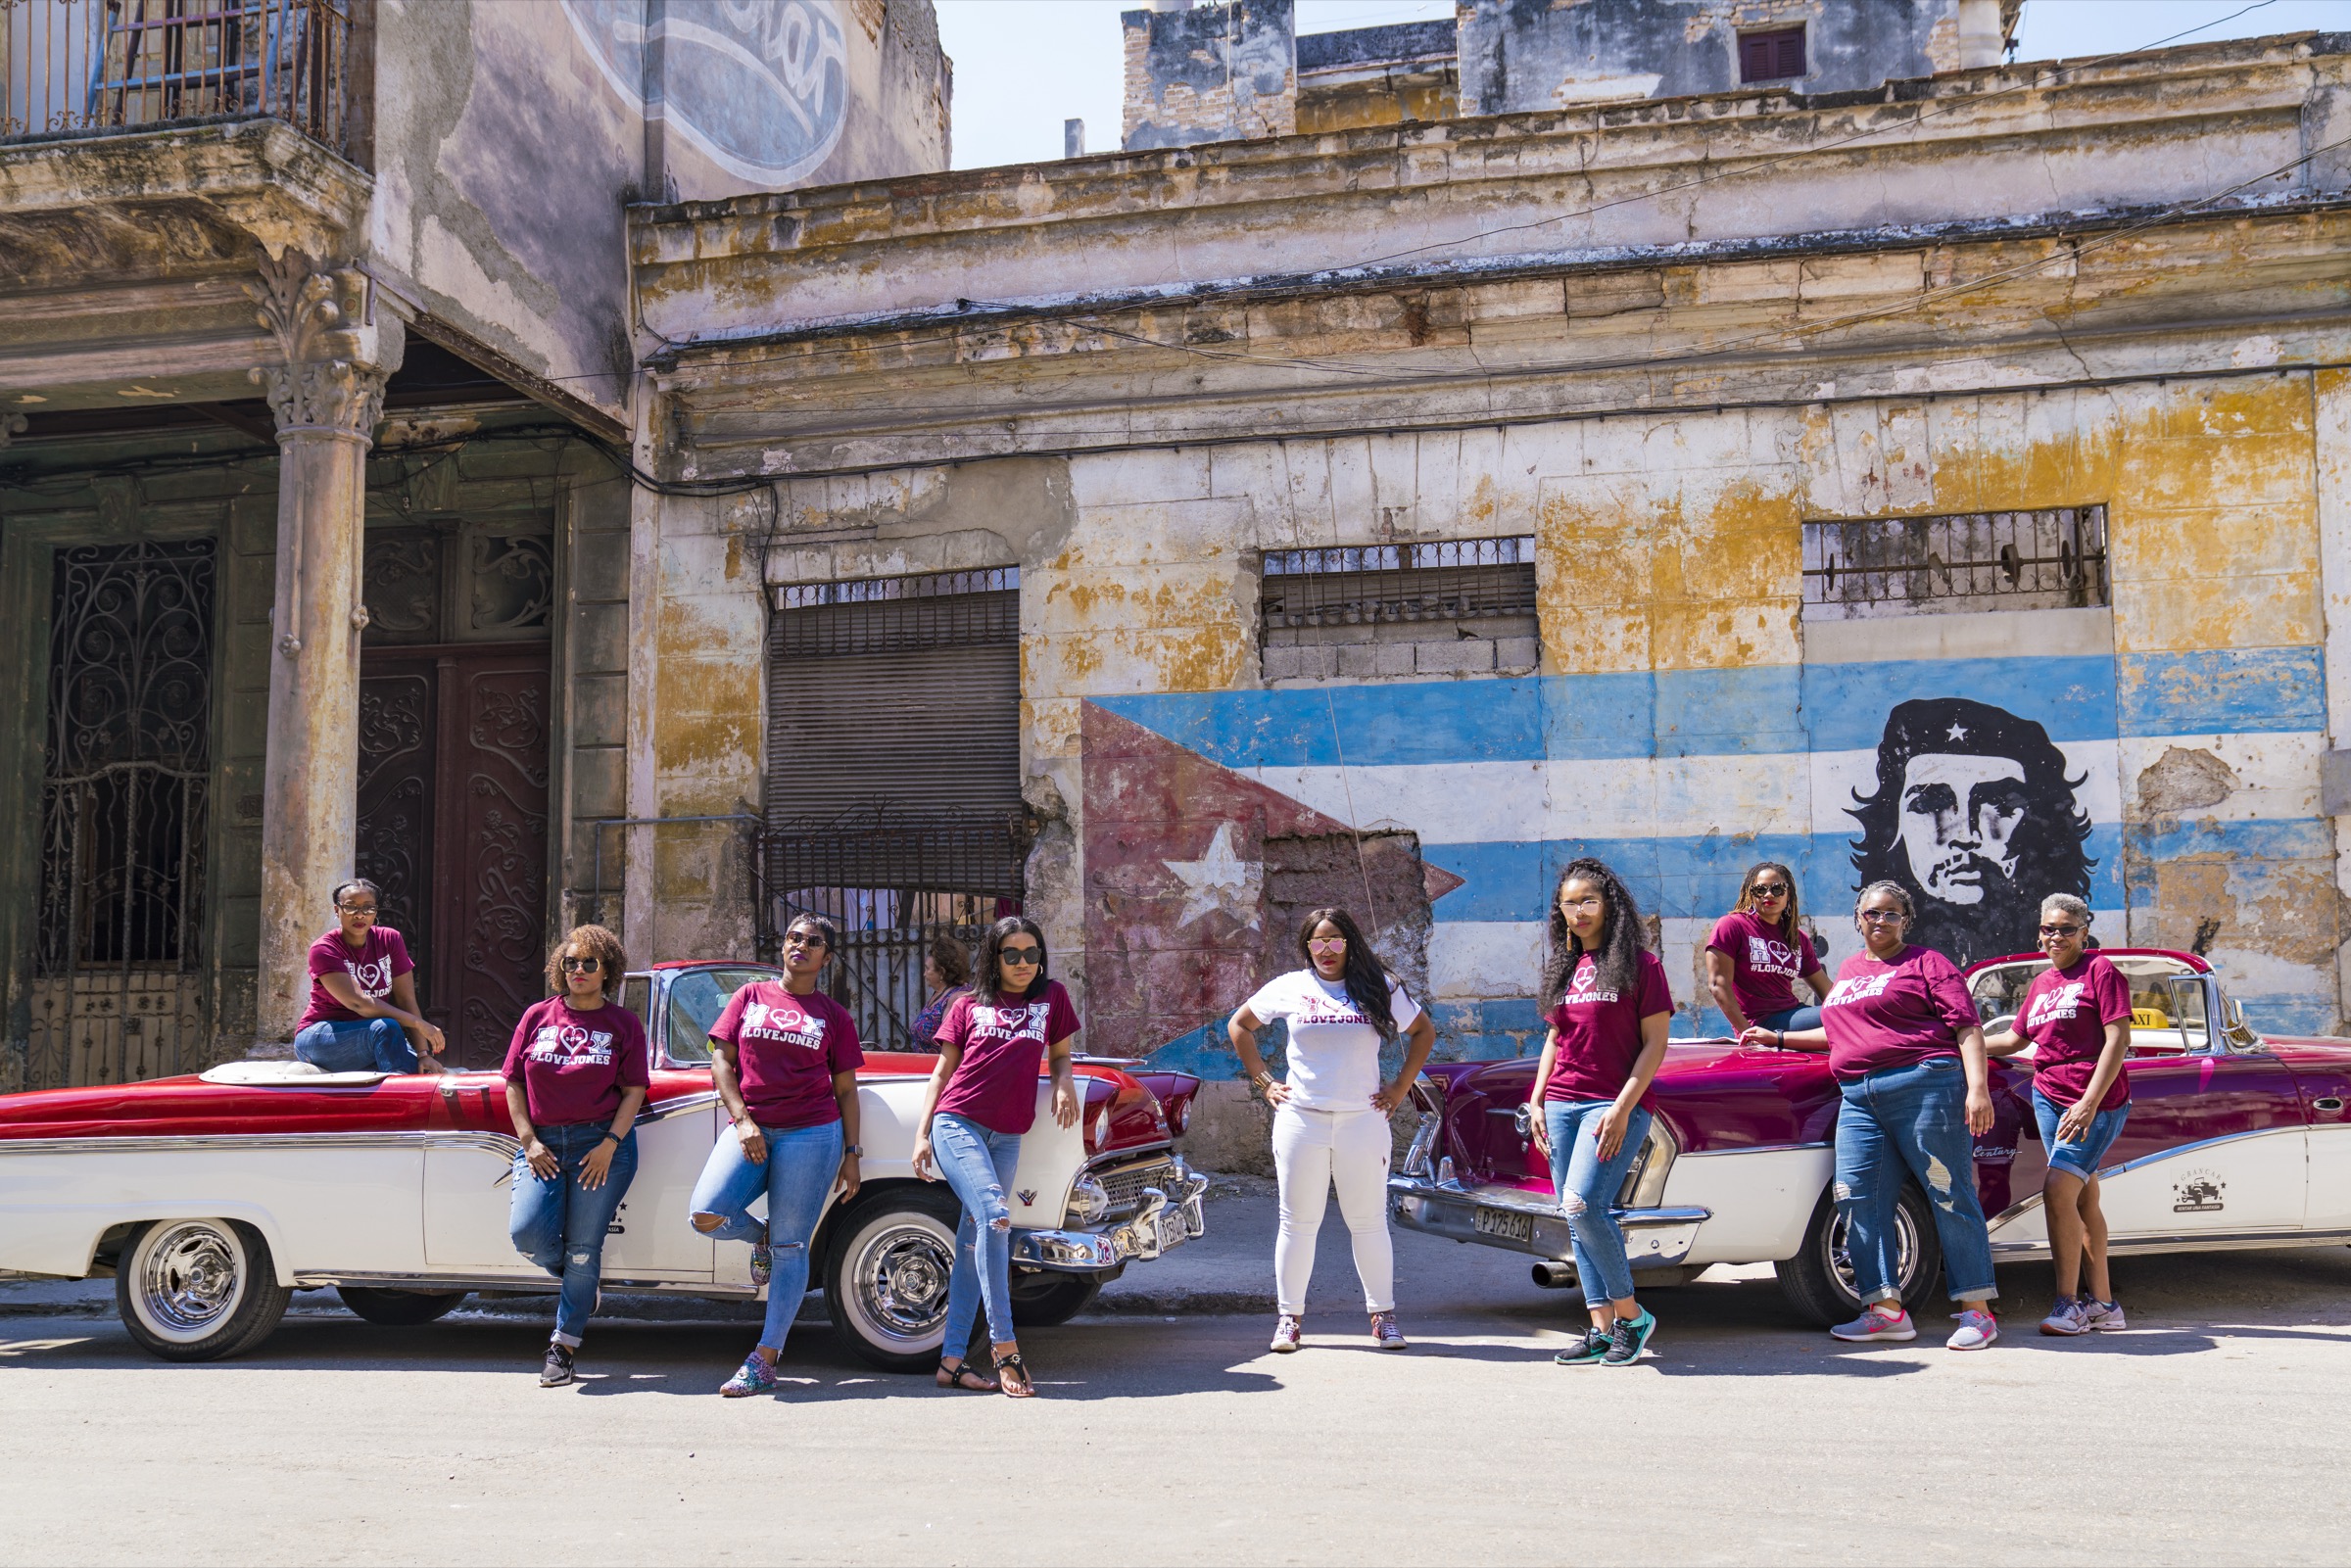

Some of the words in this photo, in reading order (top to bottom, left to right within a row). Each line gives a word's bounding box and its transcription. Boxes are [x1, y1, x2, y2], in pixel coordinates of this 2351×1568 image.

[1028, 1002, 1051, 1033] X
[1297, 1015, 1374, 1024] #LOVEJONE
[2130, 1014, 2151, 1026] AXI
[741, 1027, 822, 1051] #LOVEJONES
[529, 1051, 611, 1066] #LOVEJONES
[1972, 1145, 2022, 1159] Century
[2181, 1167, 2222, 1181] GRANCAR
